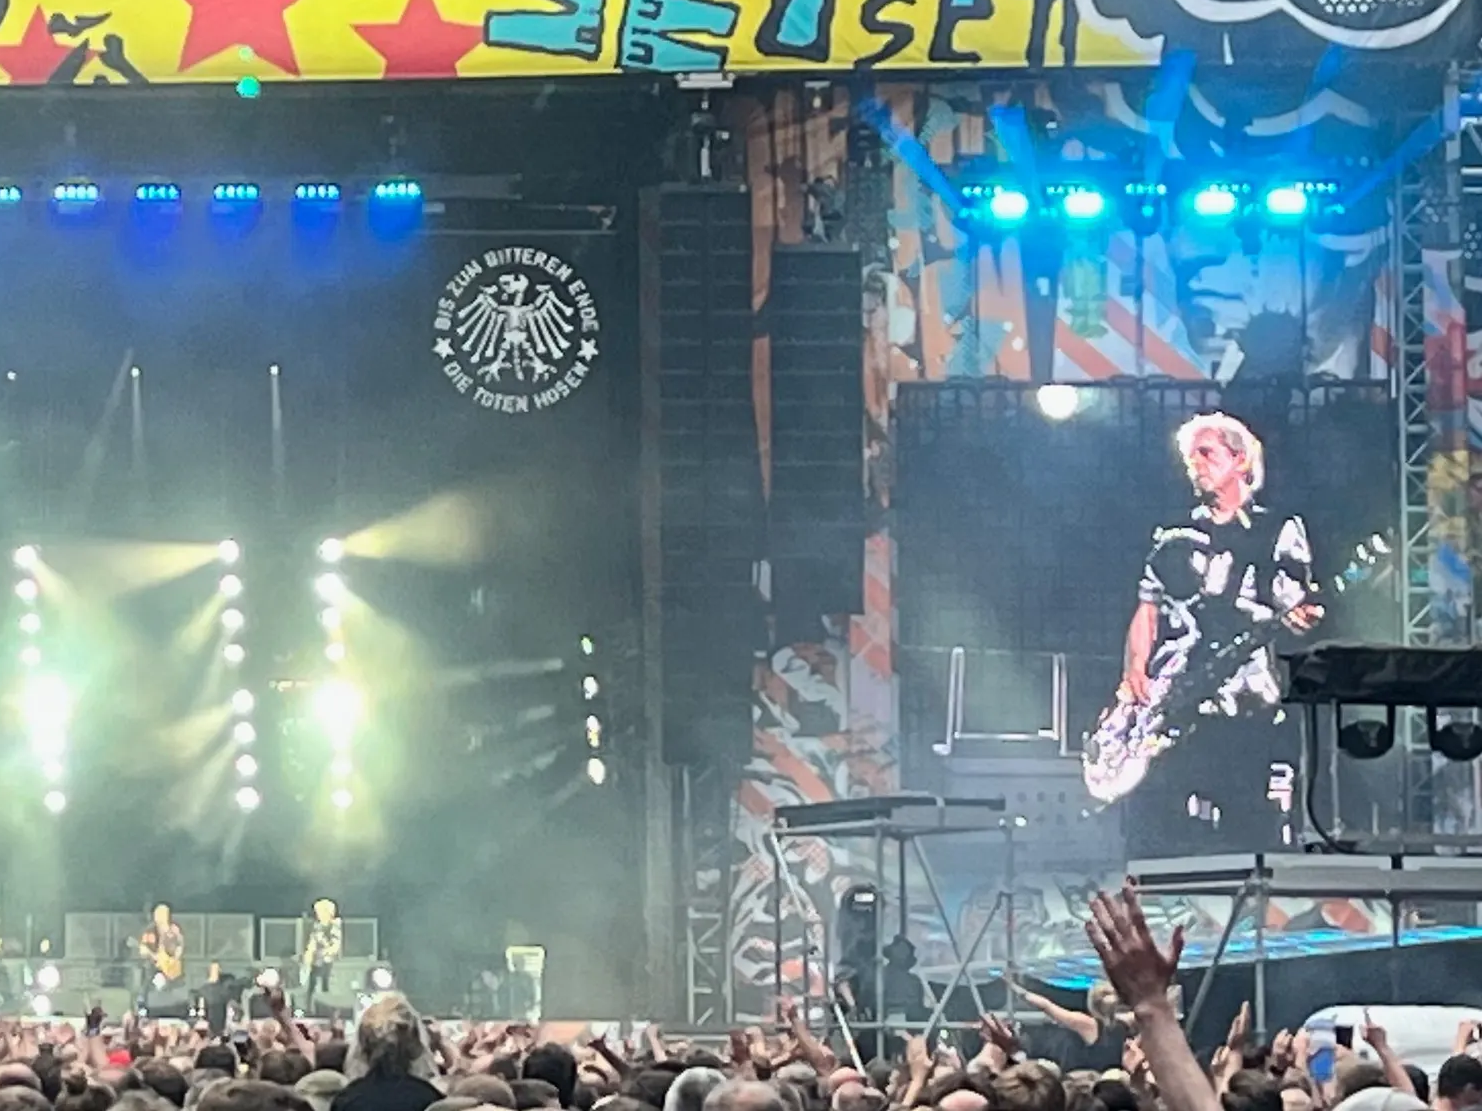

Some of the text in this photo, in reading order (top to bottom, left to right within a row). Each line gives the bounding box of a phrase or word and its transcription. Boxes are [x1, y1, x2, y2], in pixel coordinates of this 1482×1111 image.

[433, 296, 456, 331] BIS
[483, 247, 574, 282] BITTEREN
[567, 278, 600, 333] ENDE
[442, 360, 590, 414] DIE TOTEN HOSEN
